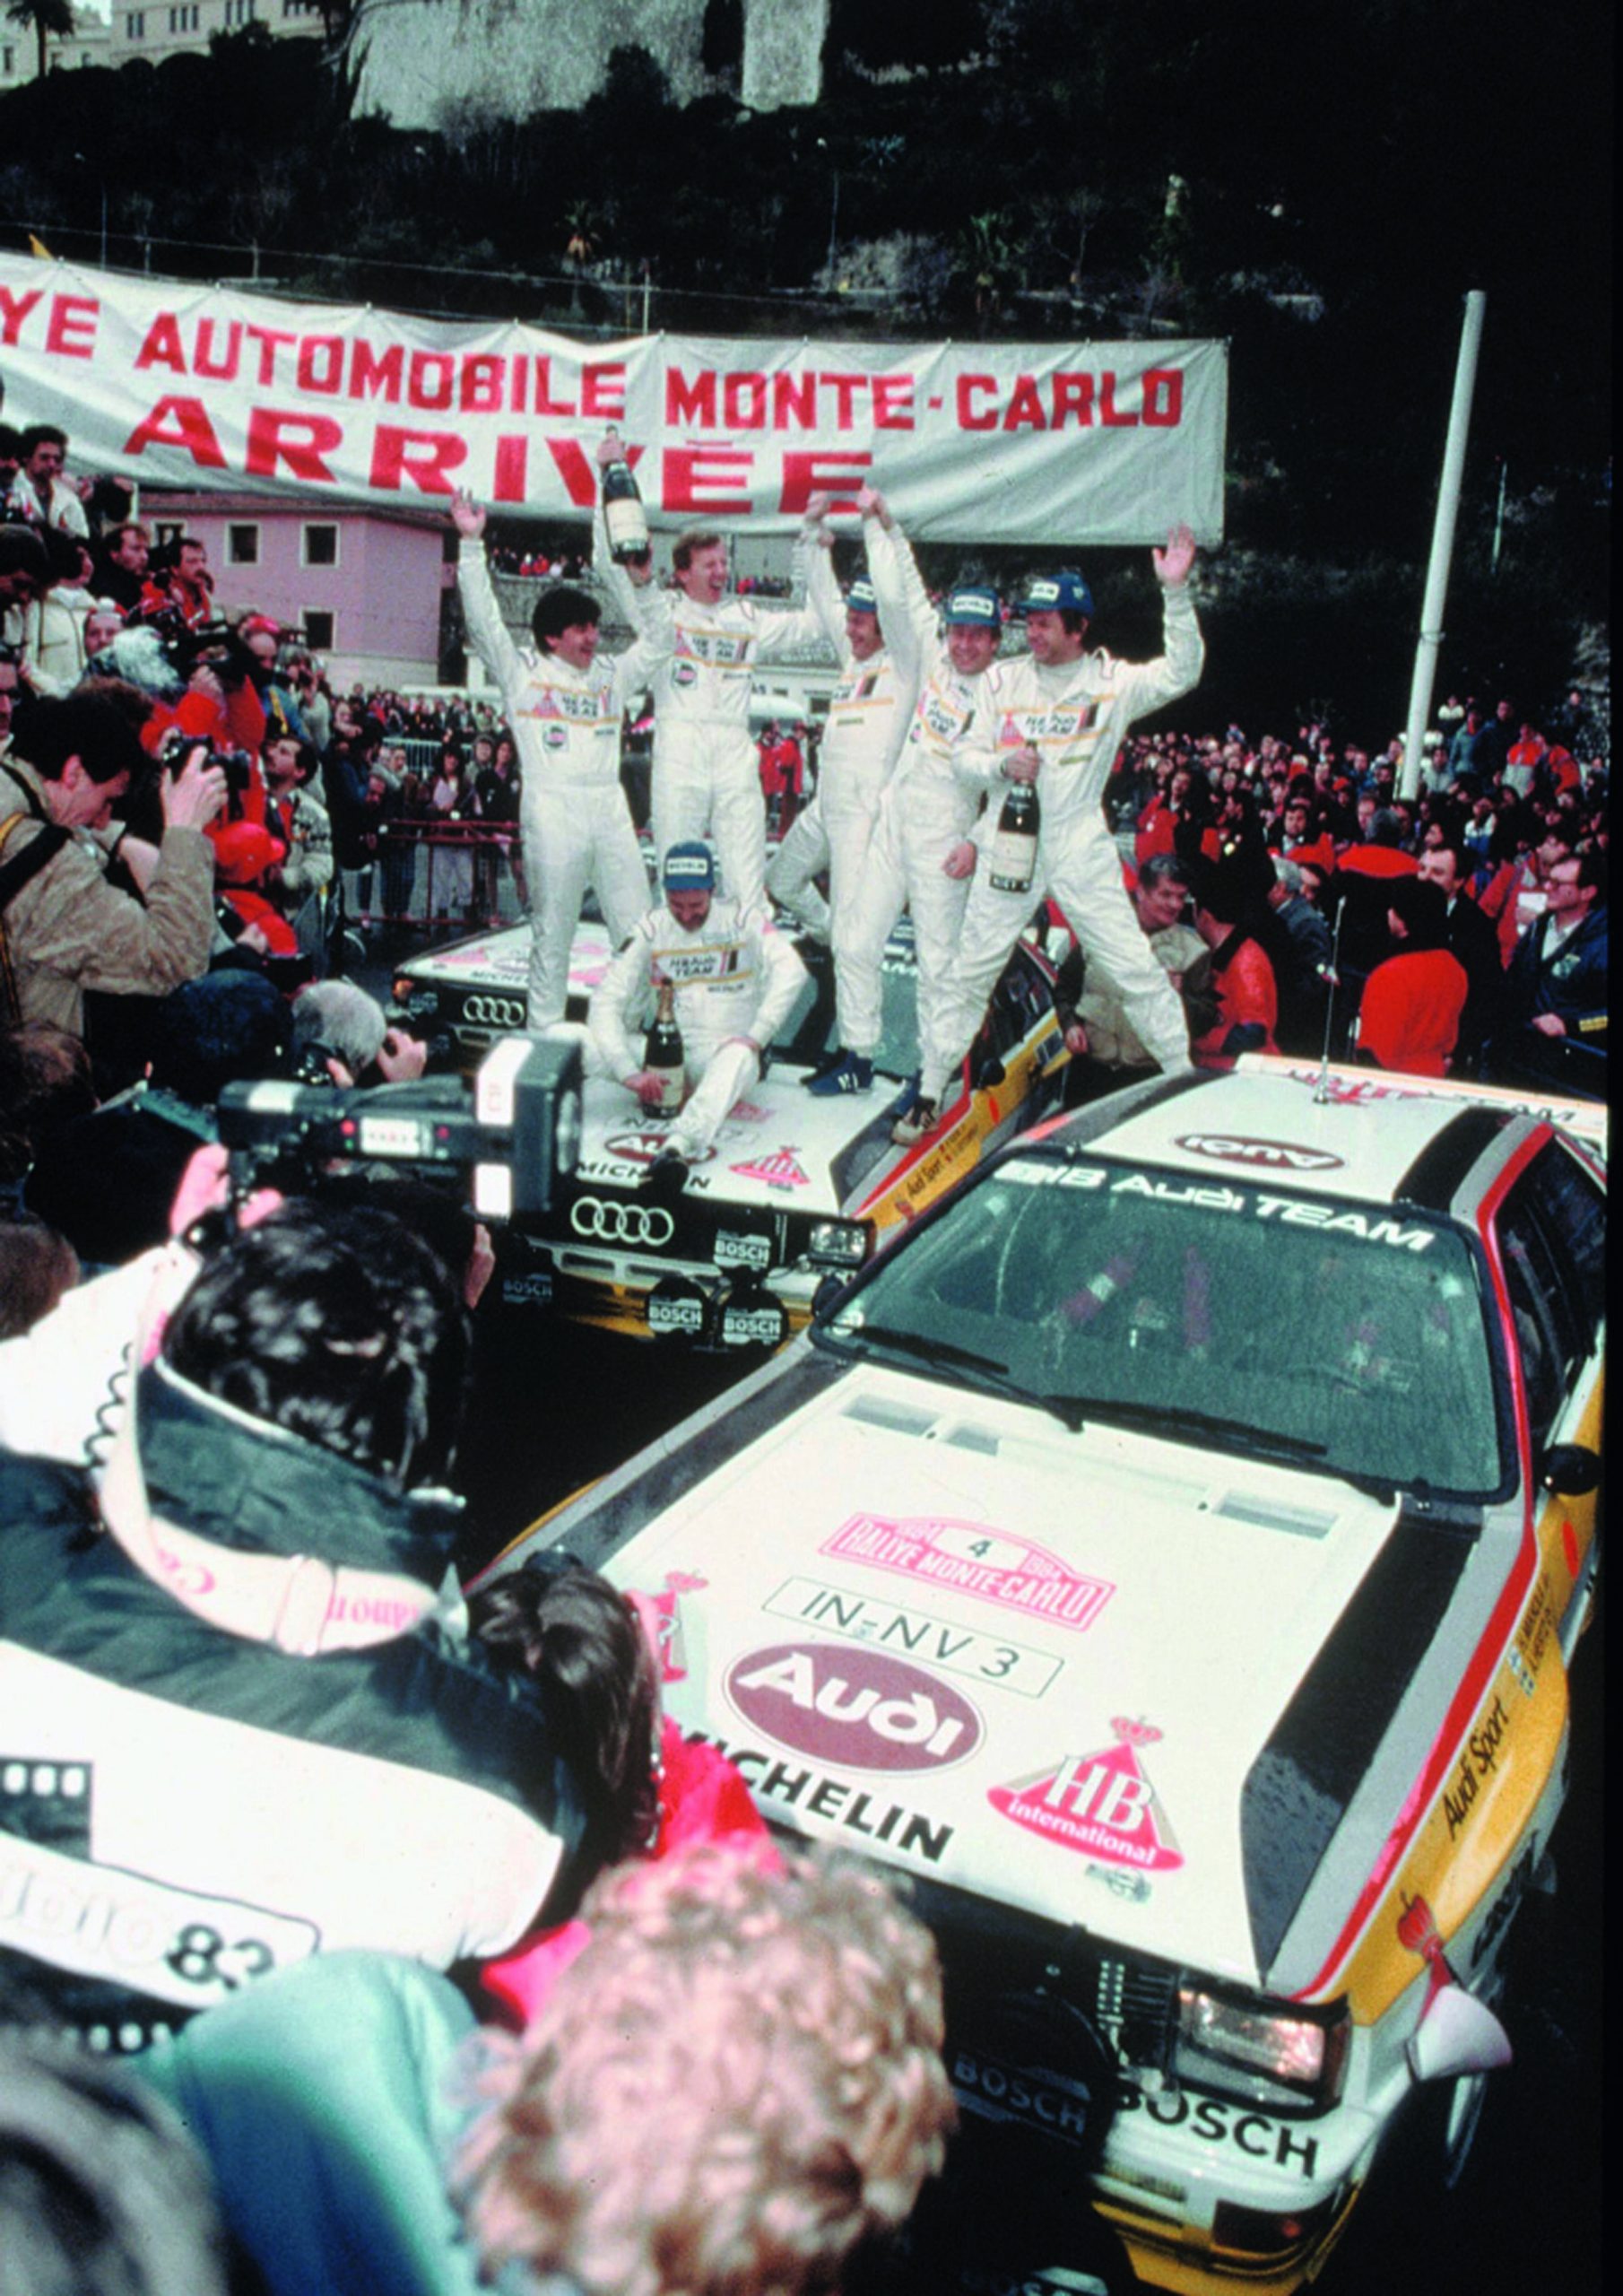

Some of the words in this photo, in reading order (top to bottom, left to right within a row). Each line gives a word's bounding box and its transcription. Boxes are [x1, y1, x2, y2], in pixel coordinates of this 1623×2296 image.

[134, 311, 627, 421] AUTOMOBILE
[665, 366, 1185, 432] MONTE-CARLO
[1255, 1195, 1435, 1252] TEAM
[715, 1239, 770, 1268] BOSCH
[648, 1305, 703, 1326] BOSCH
[723, 1316, 781, 1340] BOSCH
[836, 1520, 924, 1568] RALLYE
[968, 1539, 993, 1558] 4
[981, 1647, 1021, 1678] 3
[1044, 1754, 1155, 1833] HB
[1441, 1751, 1480, 1842] Audi
[1468, 1693, 1509, 1779] Sport
[680, 1730, 955, 1863] CHELIN
[954, 2054, 1087, 2135] BOSCH
[1116, 2089, 1319, 2179] BOSCH
